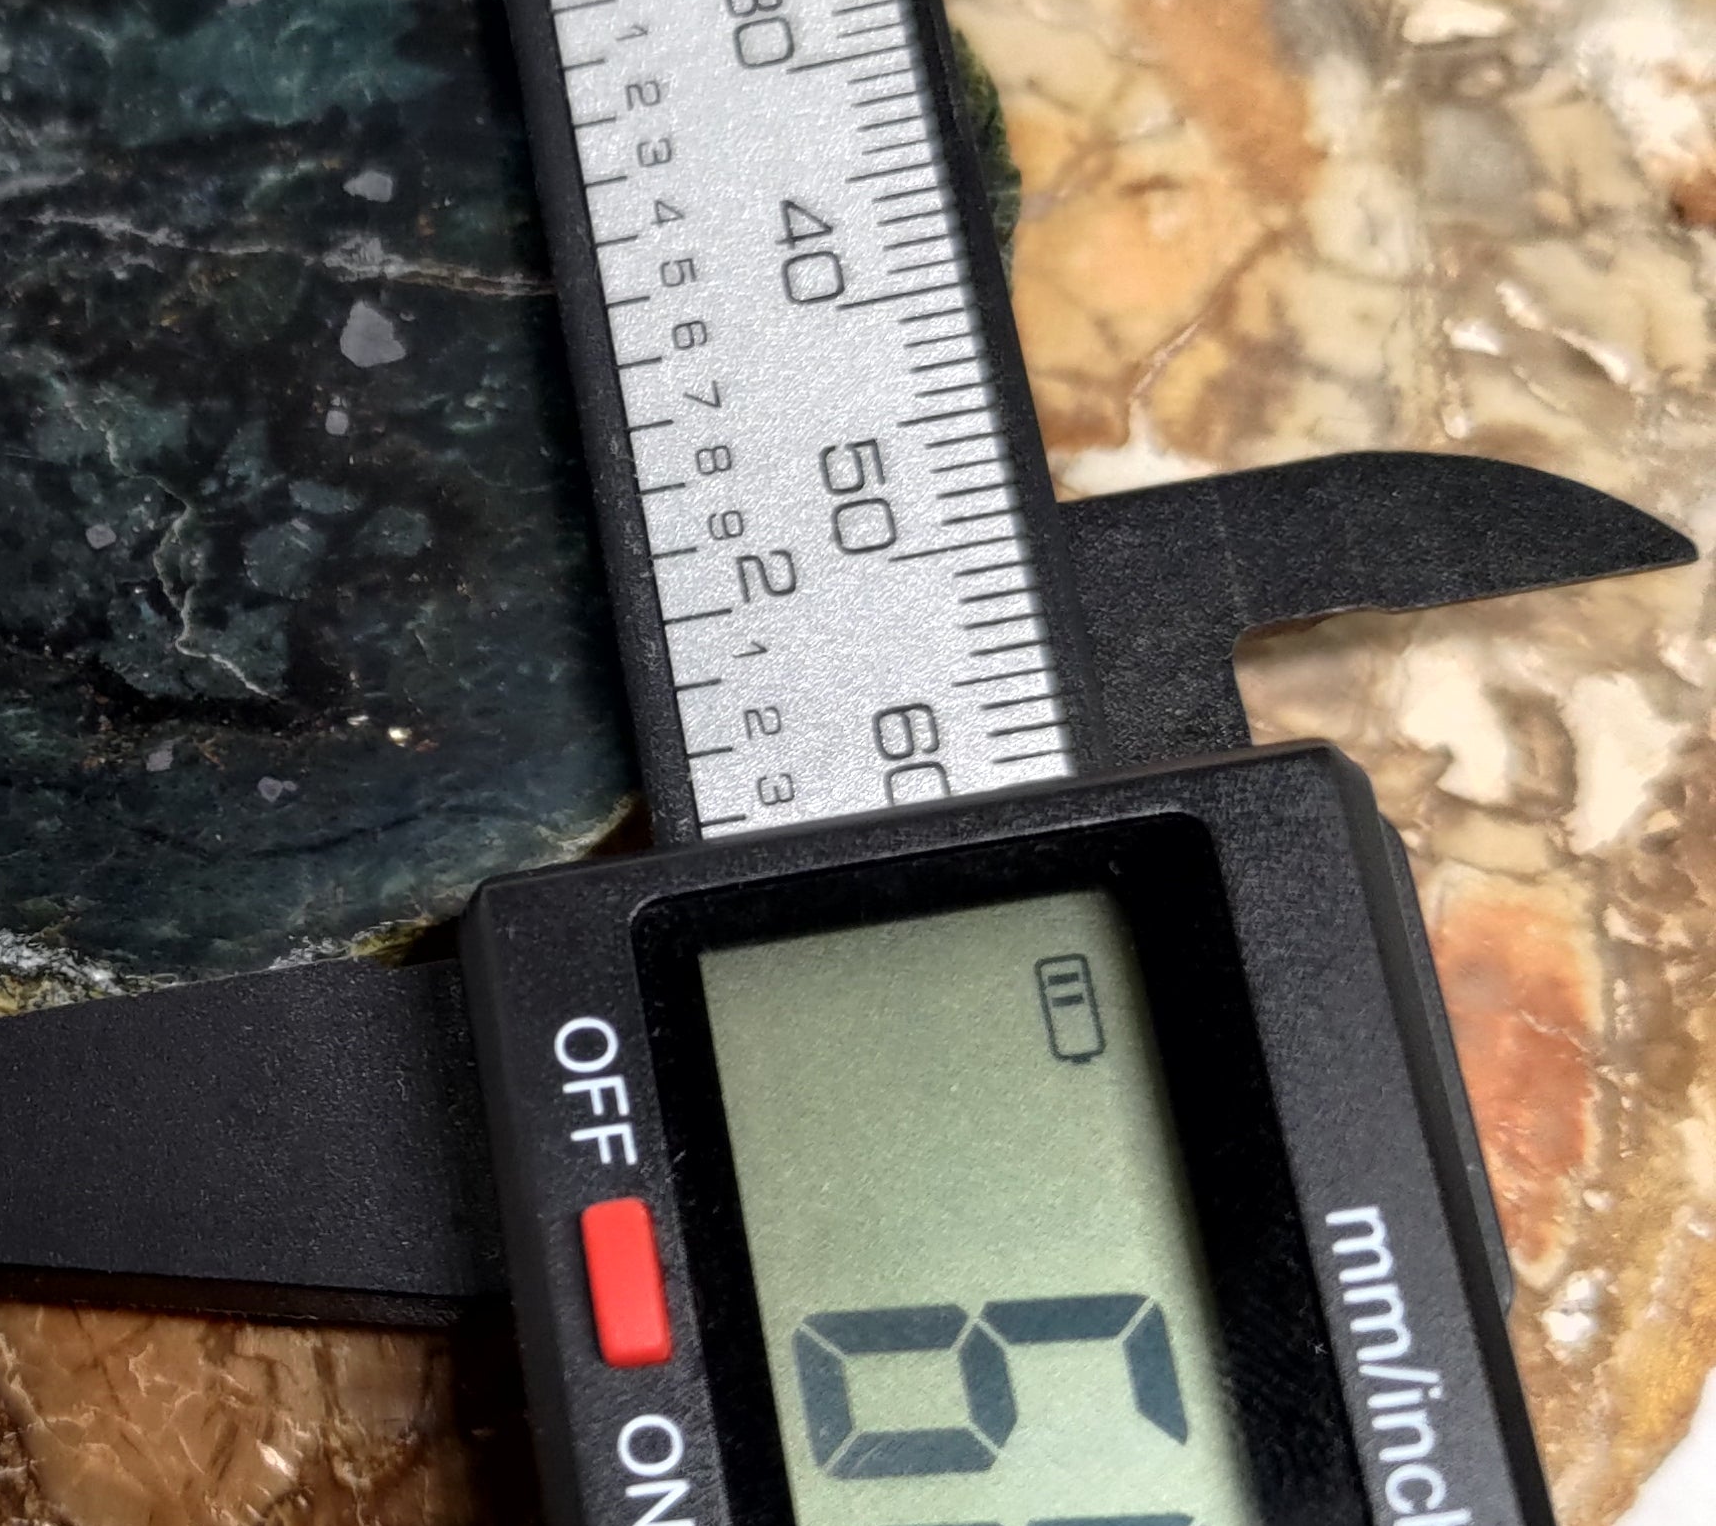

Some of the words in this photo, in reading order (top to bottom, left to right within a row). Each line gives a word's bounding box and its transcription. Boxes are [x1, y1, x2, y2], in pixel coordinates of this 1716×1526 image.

[615, 24, 649, 43] 1
[624, 79, 662, 110] 2
[638, 137, 673, 167] 3
[653, 199, 684, 225] 4
[659, 256, 698, 286] 5
[672, 320, 708, 350] 6
[684, 381, 722, 411] 7
[695, 445, 732, 475] 8
[776, 200, 845, 303] 40
[819, 439, 896, 555] 50
[873, 703, 952, 805] 60
[708, 510, 744, 541] 9
[735, 550, 796, 601] 2
[733, 640, 768, 659] 1
[743, 706, 782, 739] 2
[756, 774, 795, 805] 3
[553, 1017, 639, 1165] OFF
